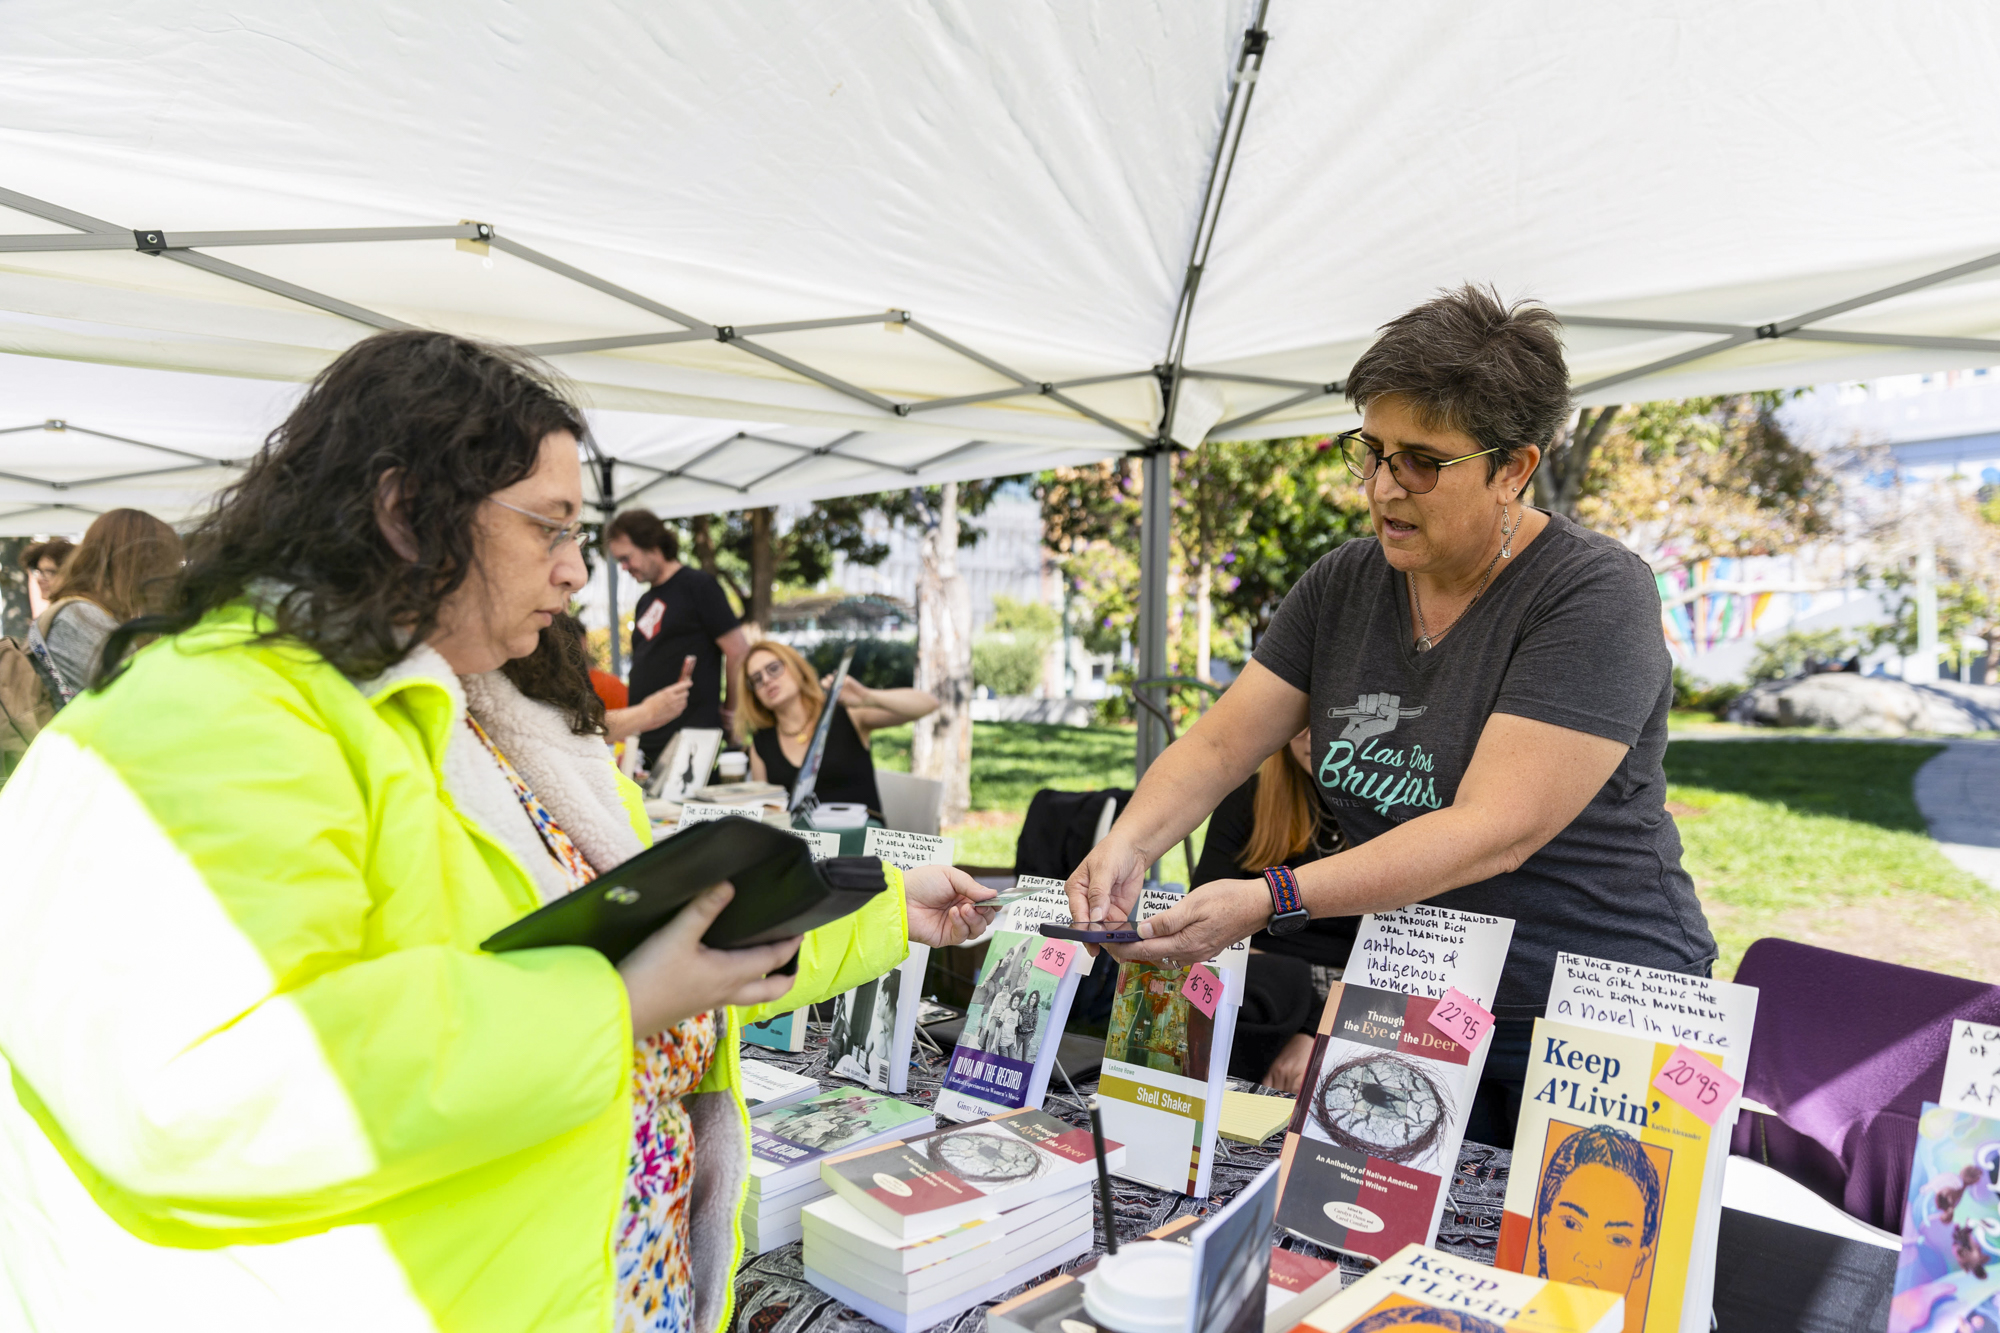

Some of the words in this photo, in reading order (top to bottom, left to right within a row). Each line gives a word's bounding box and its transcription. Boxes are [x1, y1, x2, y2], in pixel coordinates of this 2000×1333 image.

[1361, 739, 1405, 767] Las
[1409, 745, 1434, 772] Dos
[1319, 740, 1442, 816] Brujas
[1143, 891, 1149, 899] A
[1151, 891, 1179, 901] MAGICAL
[1013, 906, 1021, 916] a
[1024, 905, 1054, 920] radical
[1374, 912, 1396, 922] DOWN
[1414, 907, 1456, 920] STORIES
[1459, 913, 1499, 924] HANDED
[1363, 937, 1435, 964] anthology
[1443, 950, 1458, 969] of
[1367, 953, 1446, 982] indigenous
[1617, 966, 1632, 975] OF
[1634, 969, 1642, 978] A
[1647, 971, 1708, 989] SOUTHERN
[1369, 973, 1420, 995] women
[1368, 1011, 1405, 1027] Through
[1557, 1000, 1573, 1016] a
[1581, 1002, 1635, 1029] novel
[1643, 1014, 1662, 1033] in
[1672, 1024, 1731, 1048] verse
[1344, 1020, 1360, 1032] the
[1360, 1021, 1388, 1039] Eye
[1390, 1031, 1401, 1041] of
[1404, 1032, 1419, 1044] the
[1420, 1033, 1459, 1052] Deer
[1962, 1025, 1974, 1038] A
[1109, 1064, 1123, 1073] LeAnne
[1543, 1037, 1621, 1084] Keep
[954, 1056, 974, 1077] OLIVIA
[973, 1061, 985, 1079] ON
[983, 1063, 998, 1083] THE
[995, 1066, 1023, 1090] RECORD
[985, 1084, 990, 1092] in
[990, 1087, 1008, 1098] Women's
[1136, 1087, 1160, 1105] Shell
[1161, 1093, 1192, 1114] Shaker
[1534, 1077, 1660, 1128] A'Livin'
[1008, 1120, 1020, 1128] the
[1019, 1125, 1039, 1137] Eye
[1045, 1139, 1058, 1147] the
[1057, 1143, 1086, 1158] Deer
[1671, 1128, 1702, 1142] Alexander
[770, 1144, 809, 1159] RECORD
[1316, 1154, 1325, 1162] An
[1326, 1158, 1358, 1174] Anthology
[1358, 1167, 1366, 1175] of
[1366, 1170, 1387, 1182] Native
[1387, 1176, 1418, 1191] American
[1340, 1172, 1364, 1186] Women
[1365, 1180, 1388, 1193] Writers
[1268, 1268, 1299, 1285] eer
[1408, 1254, 1499, 1292] Keep
